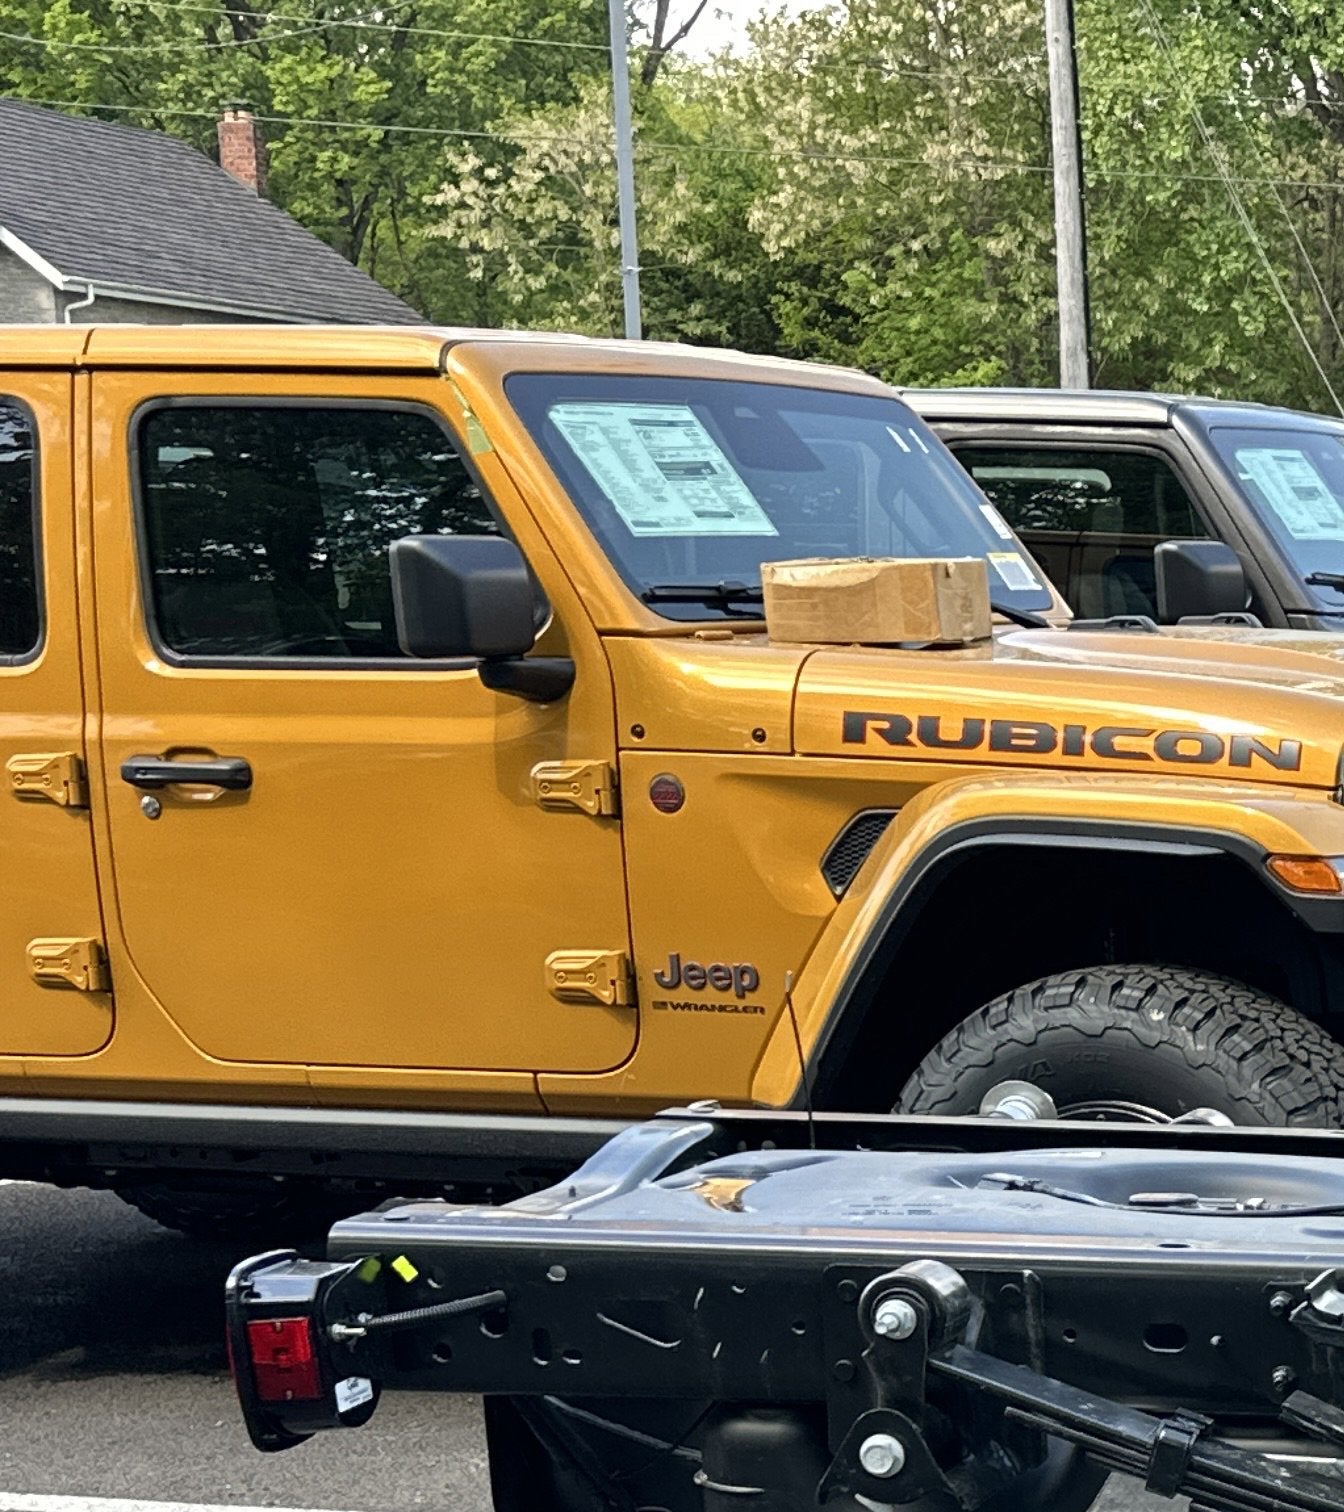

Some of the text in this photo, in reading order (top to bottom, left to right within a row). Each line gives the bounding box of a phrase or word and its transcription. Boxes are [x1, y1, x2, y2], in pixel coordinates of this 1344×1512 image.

[842, 710, 1303, 771] RUBICON
[654, 952, 760, 999] Jeep
[670, 1001, 765, 1015] WRANGLER
